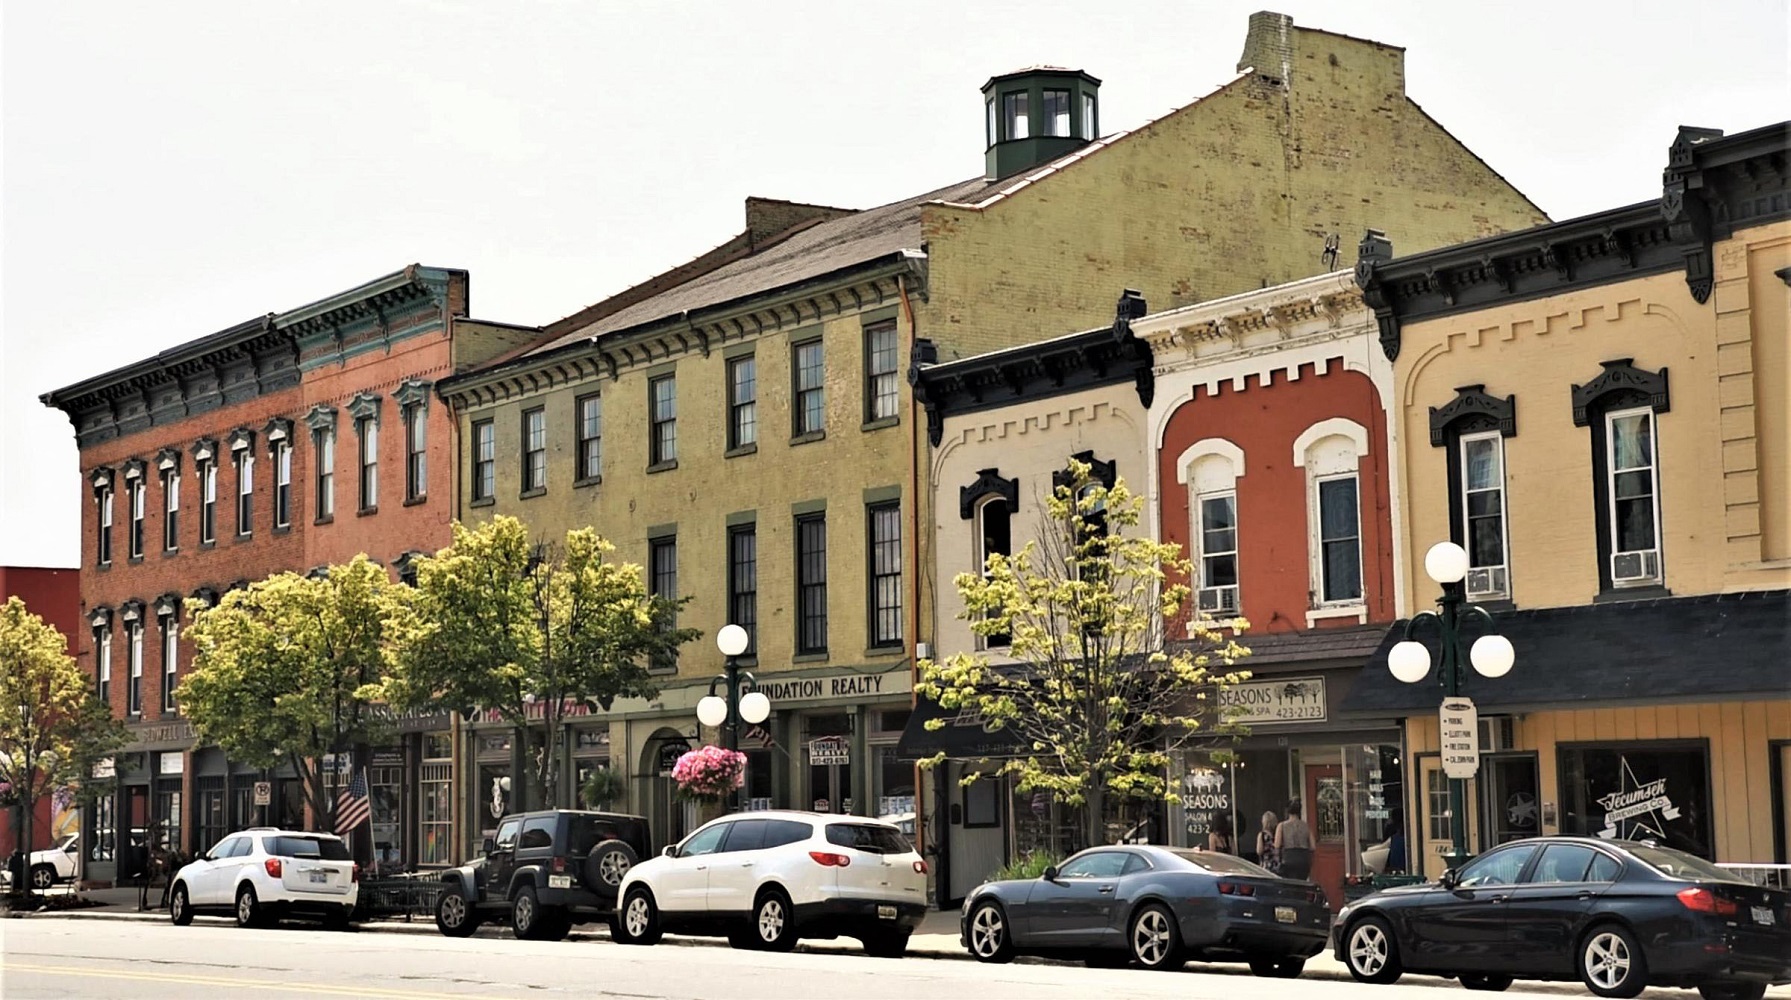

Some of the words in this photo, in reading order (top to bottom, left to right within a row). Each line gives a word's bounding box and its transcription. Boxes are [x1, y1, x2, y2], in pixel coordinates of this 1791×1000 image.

[741, 680, 823, 699] FUNDATION
[831, 675, 882, 696] REALTY
[1220, 688, 1272, 706] SEASONS
[1256, 706, 1271, 717] SPA
[1183, 794, 1228, 809] SEASONS
[1604, 778, 1667, 811] Tecumseh
[1608, 803, 1649, 821] BREWING
